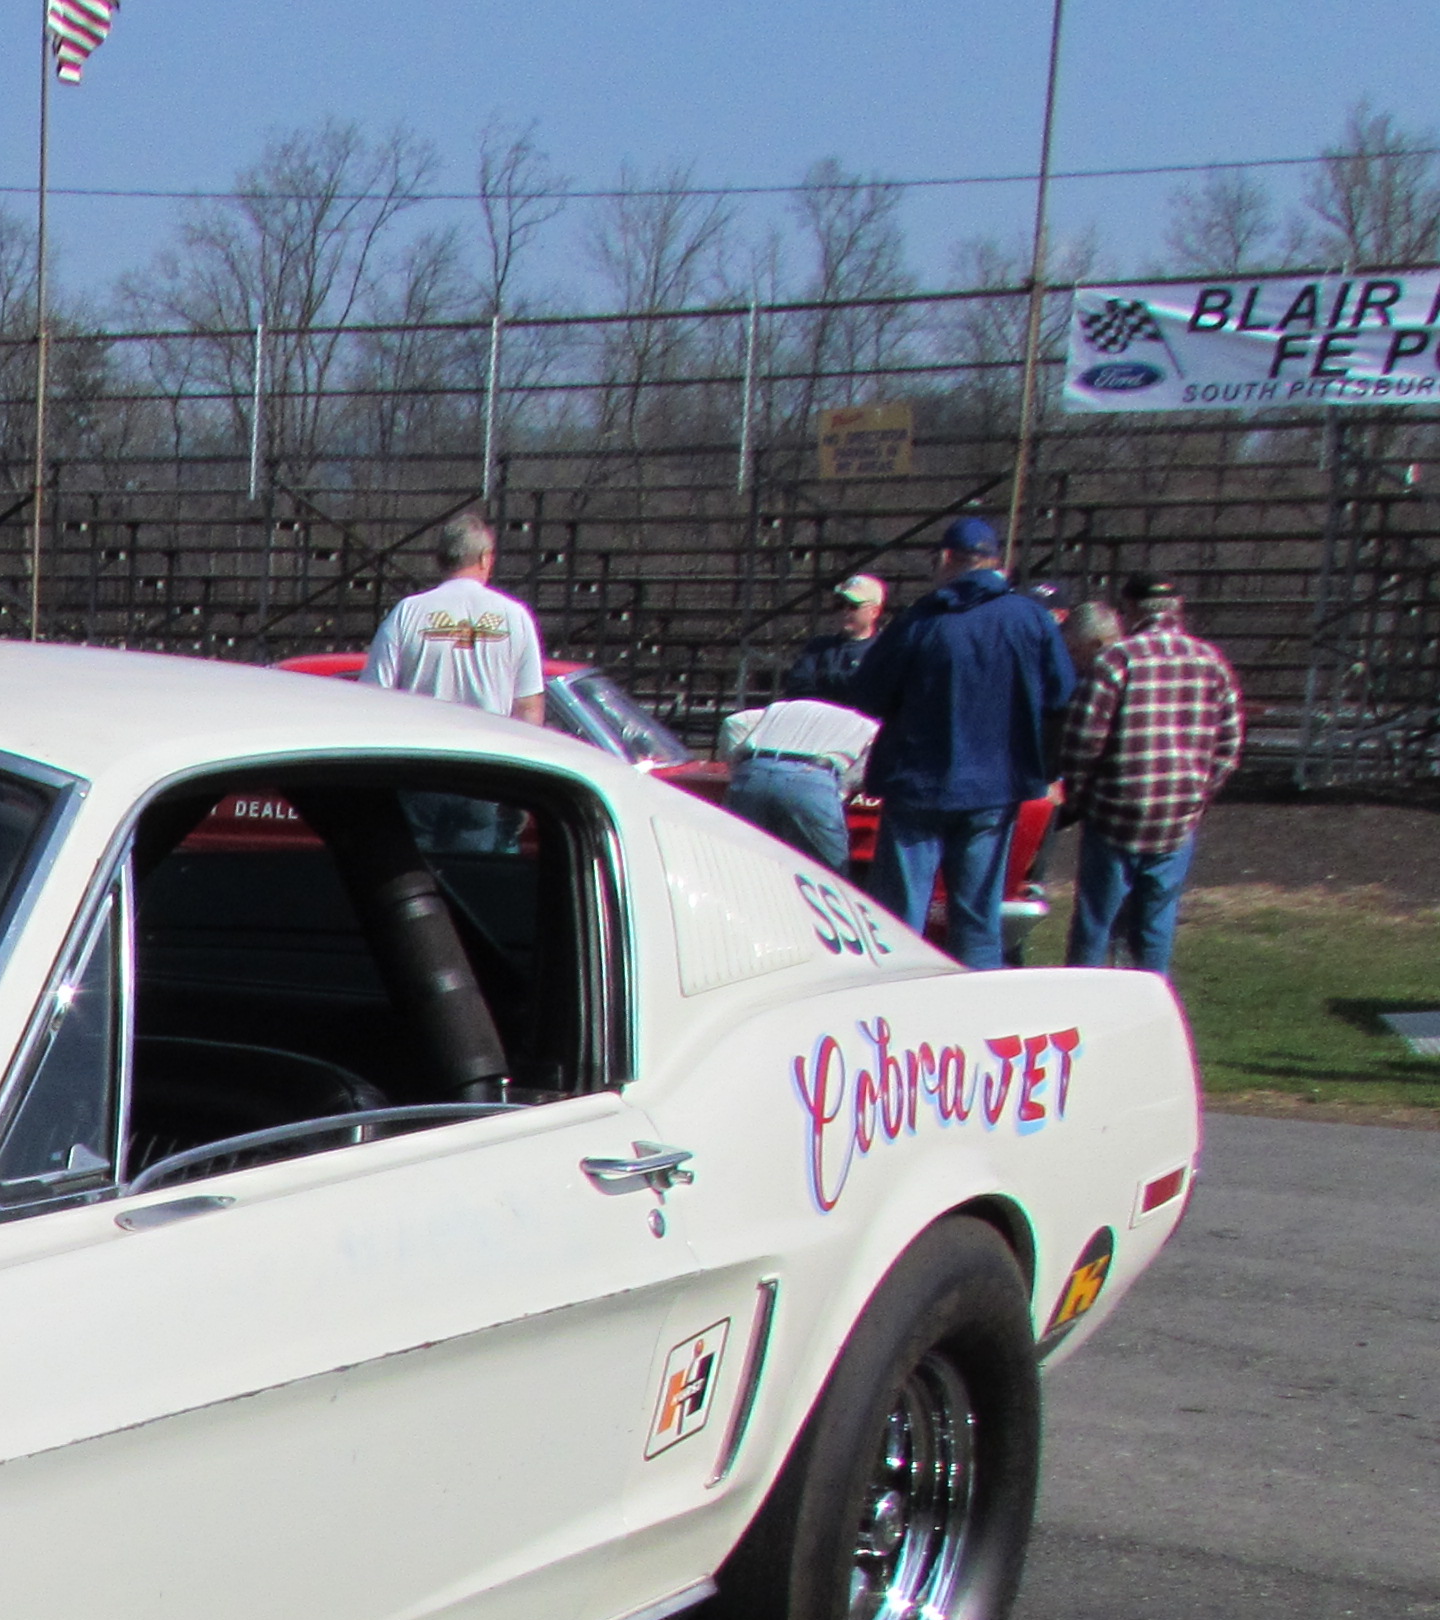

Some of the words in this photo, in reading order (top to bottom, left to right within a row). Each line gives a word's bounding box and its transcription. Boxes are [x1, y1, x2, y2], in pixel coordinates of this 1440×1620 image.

[1187, 279, 1403, 332] BLAIR
[1093, 366, 1146, 388] Ford
[1268, 331, 1361, 378] FE
[1381, 330, 1440, 375] P
[1181, 380, 1275, 403] SOUTH
[1286, 375, 1440, 401] PITTSBUR
[792, 1016, 980, 1215] Cobra
[980, 1025, 1082, 1135] JET
